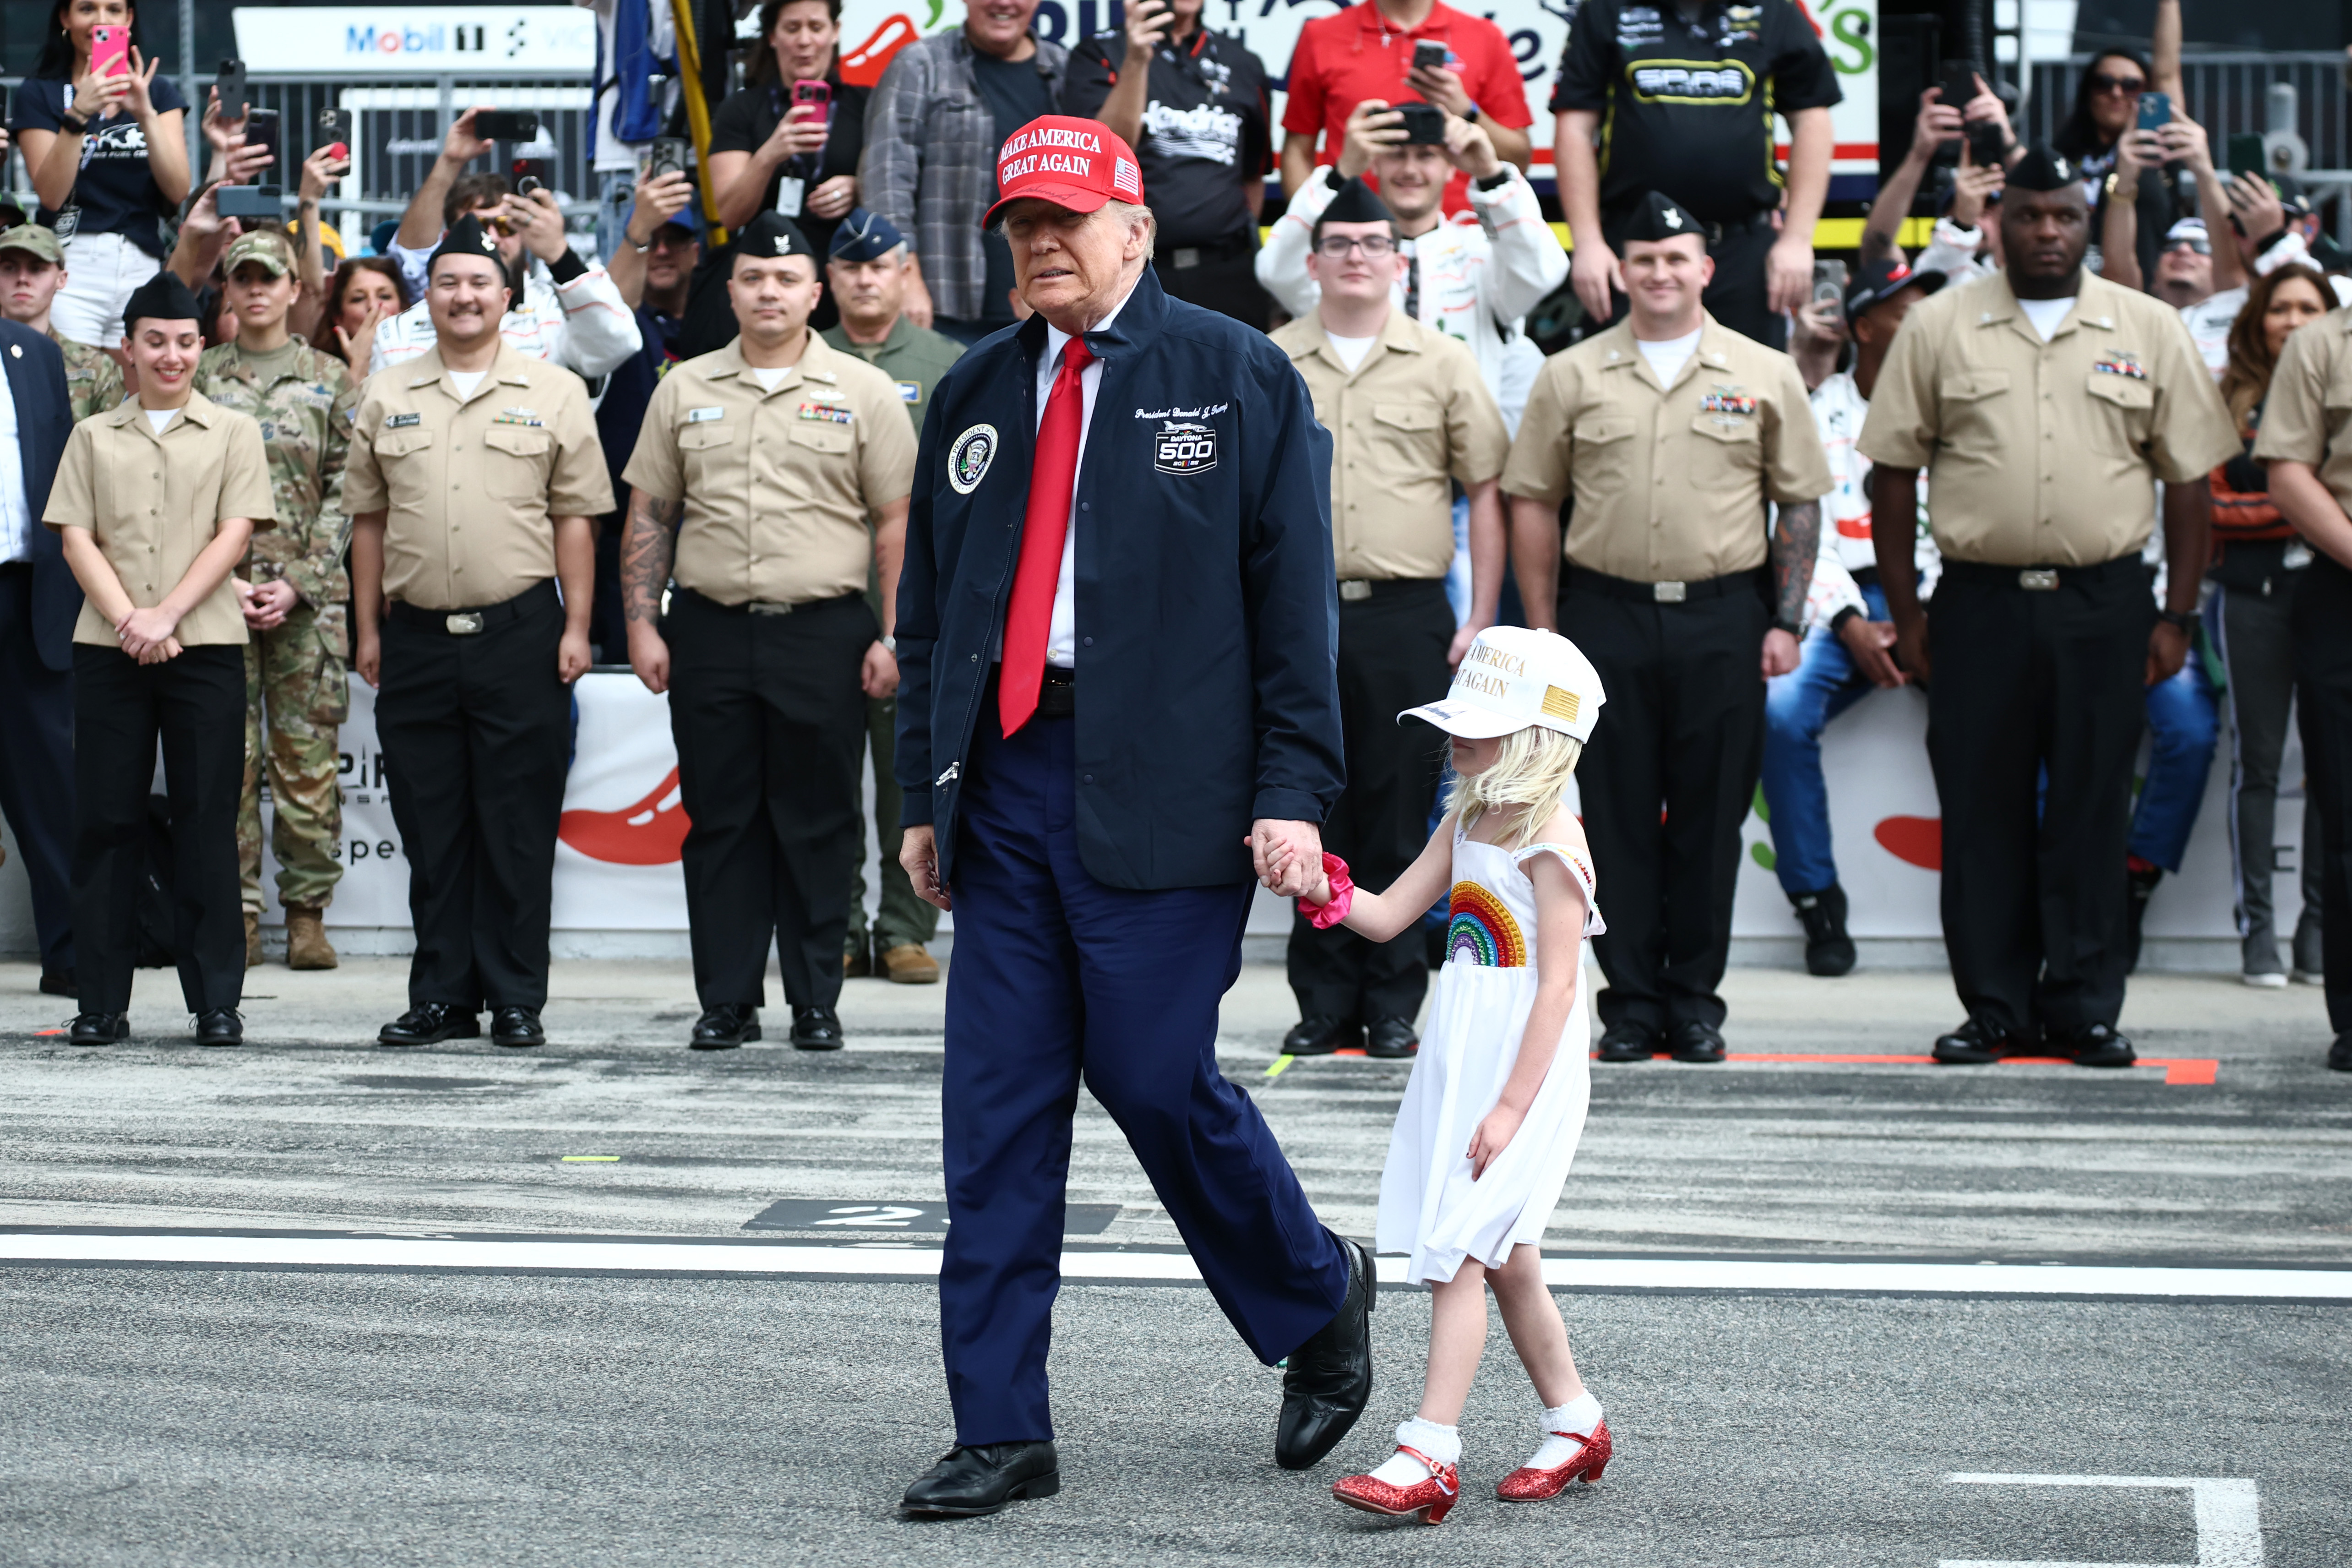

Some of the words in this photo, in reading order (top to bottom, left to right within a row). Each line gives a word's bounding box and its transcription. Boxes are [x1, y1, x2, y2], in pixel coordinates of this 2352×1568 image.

[347, 25, 444, 52] Mobil
[999, 133, 1028, 164] MAKE
[1028, 129, 1101, 153] AMERICA
[1002, 154, 1037, 185] GREAT
[1038, 153, 1091, 177] AGAIN
[1135, 408, 1171, 419] President
[1172, 407, 1201, 417] Donald
[1202, 406, 1210, 419] J.
[953, 426, 985, 453] PRESIDENT
[1159, 441, 1213, 460] 500
[952, 474, 962, 490] SEAL
[1468, 644, 1525, 677] AMERICA
[1462, 670, 1510, 699] AGAIN
